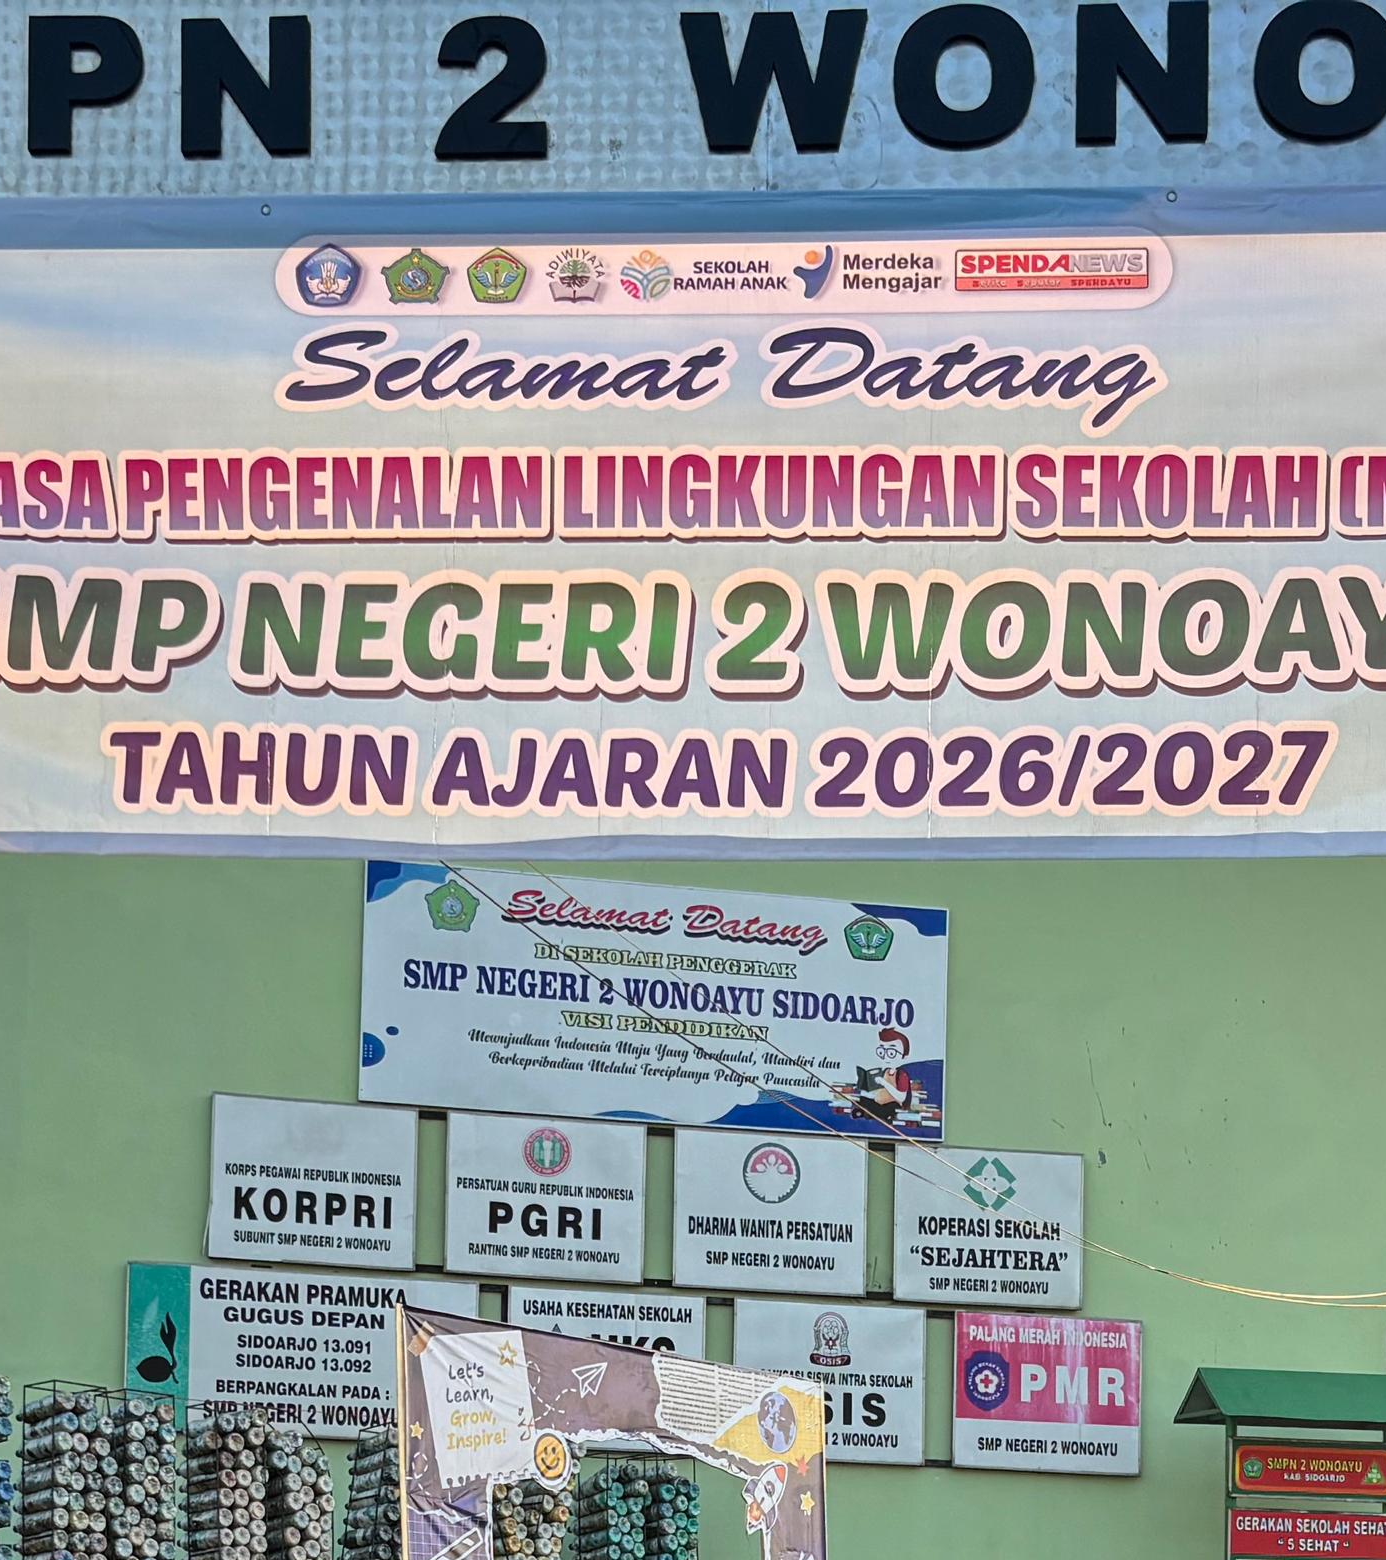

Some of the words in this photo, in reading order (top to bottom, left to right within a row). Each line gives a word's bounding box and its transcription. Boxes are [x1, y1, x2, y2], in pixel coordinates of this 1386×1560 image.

[434, 15, 549, 161] 2
[545, 247, 607, 280] ADIWIYATA
[692, 260, 770, 275] SEKOLAH
[843, 253, 935, 271] Merdeka
[673, 277, 735, 291] RAMAH
[740, 276, 788, 290] ANAK
[843, 272, 943, 293] Mengajar
[285, 330, 727, 401] Selamat
[770, 326, 1156, 428] Datang
[125, 454, 545, 533] PENGENALAN
[566, 454, 997, 532] LINGKUNGAN
[1018, 454, 1317, 532] SEKOLAH
[243, 577, 680, 686] NEGERI
[714, 583, 797, 682] 2
[110, 730, 408, 808] TAHUN
[429, 733, 789, 808] AJARAN
[818, 727, 1331, 808] 2026/2027
[503, 889, 673, 934] Selamat
[683, 904, 828, 956] Datang
[563, 945, 663, 968] SEKOLAH
[668, 953, 797, 979] PENGGERAK
[404, 959, 467, 992] SMP
[476, 965, 589, 1002] NEGERI
[599, 977, 614, 1005] 2
[623, 977, 764, 1017] WONOAYU
[772, 989, 914, 1028] SIDOARJO
[561, 1011, 612, 1030] VISI
[617, 1015, 769, 1041] PENDIDIKAN
[468, 1028, 550, 1049] Mewujudkan
[554, 1035, 611, 1053] Indonesia
[615, 1041, 650, 1059] Maju
[654, 1043, 689, 1064] Yang
[761, 1052, 815, 1069] Mandiri
[818, 1056, 841, 1070] dan
[488, 1051, 584, 1071] Berkepribadian
[588, 1058, 637, 1076] Melalui
[640, 1063, 710, 1084] Terciptanya
[714, 1068, 759, 1087] Pelajar
[763, 1071, 821, 1089] Pancasila
[225, 1163, 257, 1178] KORPS
[259, 1164, 301, 1180] PEGAWAI
[303, 1168, 349, 1183] REPUBLIK
[351, 1171, 401, 1187] INDONESIA
[456, 1176, 509, 1194] PERSATUAN
[511, 1181, 537, 1195] GURU
[539, 1182, 583, 1198] REPUBLIK
[585, 1185, 634, 1201] INDONESIA
[233, 1186, 393, 1229] KORPRI
[488, 1201, 603, 1241] PGRI
[688, 1216, 737, 1238] DHARMA
[740, 1218, 785, 1240] WANITA
[787, 1222, 853, 1243] PERSATUAN
[918, 1215, 990, 1239] KOPERASI
[994, 1218, 1061, 1241] SEKOLAH
[233, 1229, 275, 1245] SUBUNIT
[277, 1232, 298, 1246] SMP
[299, 1233, 334, 1249] NEGERI
[344, 1236, 391, 1252] WONOAYU
[468, 1242, 508, 1258] RANTING
[510, 1245, 530, 1259] SMP
[531, 1246, 565, 1261] NEGERI
[575, 1249, 620, 1265] WONOAYU
[706, 1250, 728, 1265] SMP
[731, 1252, 770, 1268] NEGERI
[782, 1255, 835, 1271] WONOAYU
[199, 1278, 300, 1304] GERAKAN
[306, 1283, 407, 1308] PRAMUKA
[929, 1277, 950, 1291] SMP
[953, 1278, 989, 1293] NEGERI
[991, 1279, 998, 1293] 2
[1000, 1280, 1049, 1295] WONOAYU
[223, 1306, 304, 1326] GUGUS
[312, 1311, 385, 1329] DEPAN
[523, 1299, 563, 1316] USAHA
[566, 1302, 635, 1320] KESEHATAN
[638, 1306, 692, 1323] SEKOLAH
[237, 1334, 317, 1352] SIDOARJO
[322, 1339, 372, 1354] 13.091
[969, 1325, 1015, 1342] PALANG
[1019, 1328, 1060, 1345] MERAH
[1064, 1330, 1127, 1349] INDONESIA
[236, 1354, 315, 1371] SIDOARJO
[321, 1358, 372, 1373] 13.092
[448, 1362, 485, 1381] Let's
[216, 1379, 337, 1398] BERPANGKALAN
[341, 1385, 381, 1400] PADA
[838, 1373, 866, 1387] INTRA
[869, 1374, 913, 1388] SEKOLAH
[1020, 1363, 1126, 1407] PMR
[446, 1386, 494, 1404] Learn,
[307, 1404, 317, 1424] 2
[450, 1409, 497, 1427] Grow,
[447, 1430, 507, 1451] Inspire!
[842, 1434, 898, 1448] WONOAYU
[977, 1437, 1002, 1451] SMP
[1005, 1438, 1047, 1453] NEGERI
[1051, 1440, 1057, 1454] 2
[1061, 1441, 1118, 1456] WONOAYU
[1267, 1457, 1297, 1470] SMPN
[1309, 1460, 1362, 1472] WONOAYU
[1236, 1516, 1292, 1532] GERAKAN
[1296, 1518, 1350, 1534] SEKOLAH
[1298, 1538, 1339, 1552] SEHAT
